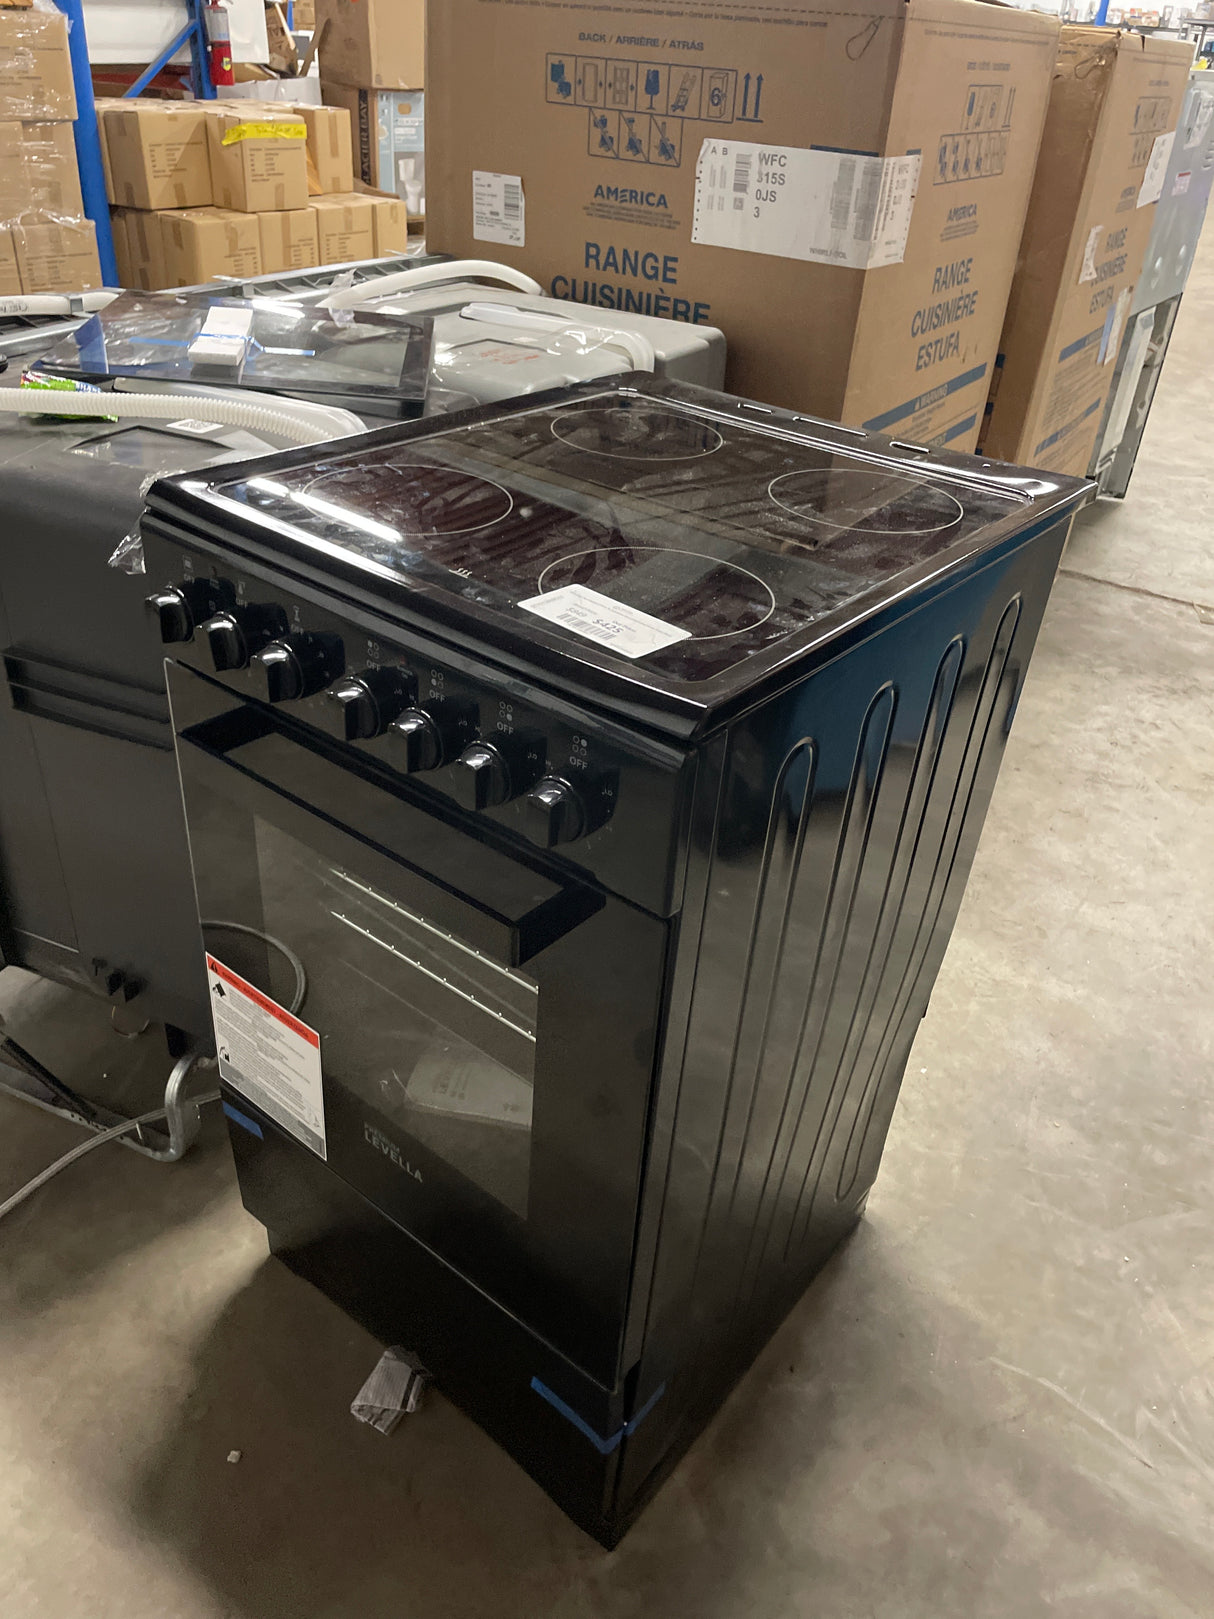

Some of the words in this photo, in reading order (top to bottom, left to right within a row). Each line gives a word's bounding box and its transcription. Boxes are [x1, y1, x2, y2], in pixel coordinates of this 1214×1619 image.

[578, 32, 606, 43] BACK
[361, 131, 371, 186] LACIER
[710, 146, 717, 155] A
[722, 147, 728, 155] B
[759, 151, 787, 167] WFC
[593, 184, 669, 209] AMERICA
[753, 206, 760, 218] 3
[584, 241, 679, 285] RANGE
[932, 257, 973, 295] RANGE
[911, 288, 978, 338] CUISINIÈRE
[915, 330, 961, 372] ESTUFA
[366, 659, 381, 672] OFF
[429, 689, 446, 703] OFF
[496, 721, 514, 735] OFF
[569, 756, 588, 770] OFF
[364, 1129, 424, 1184] LEVELLA
